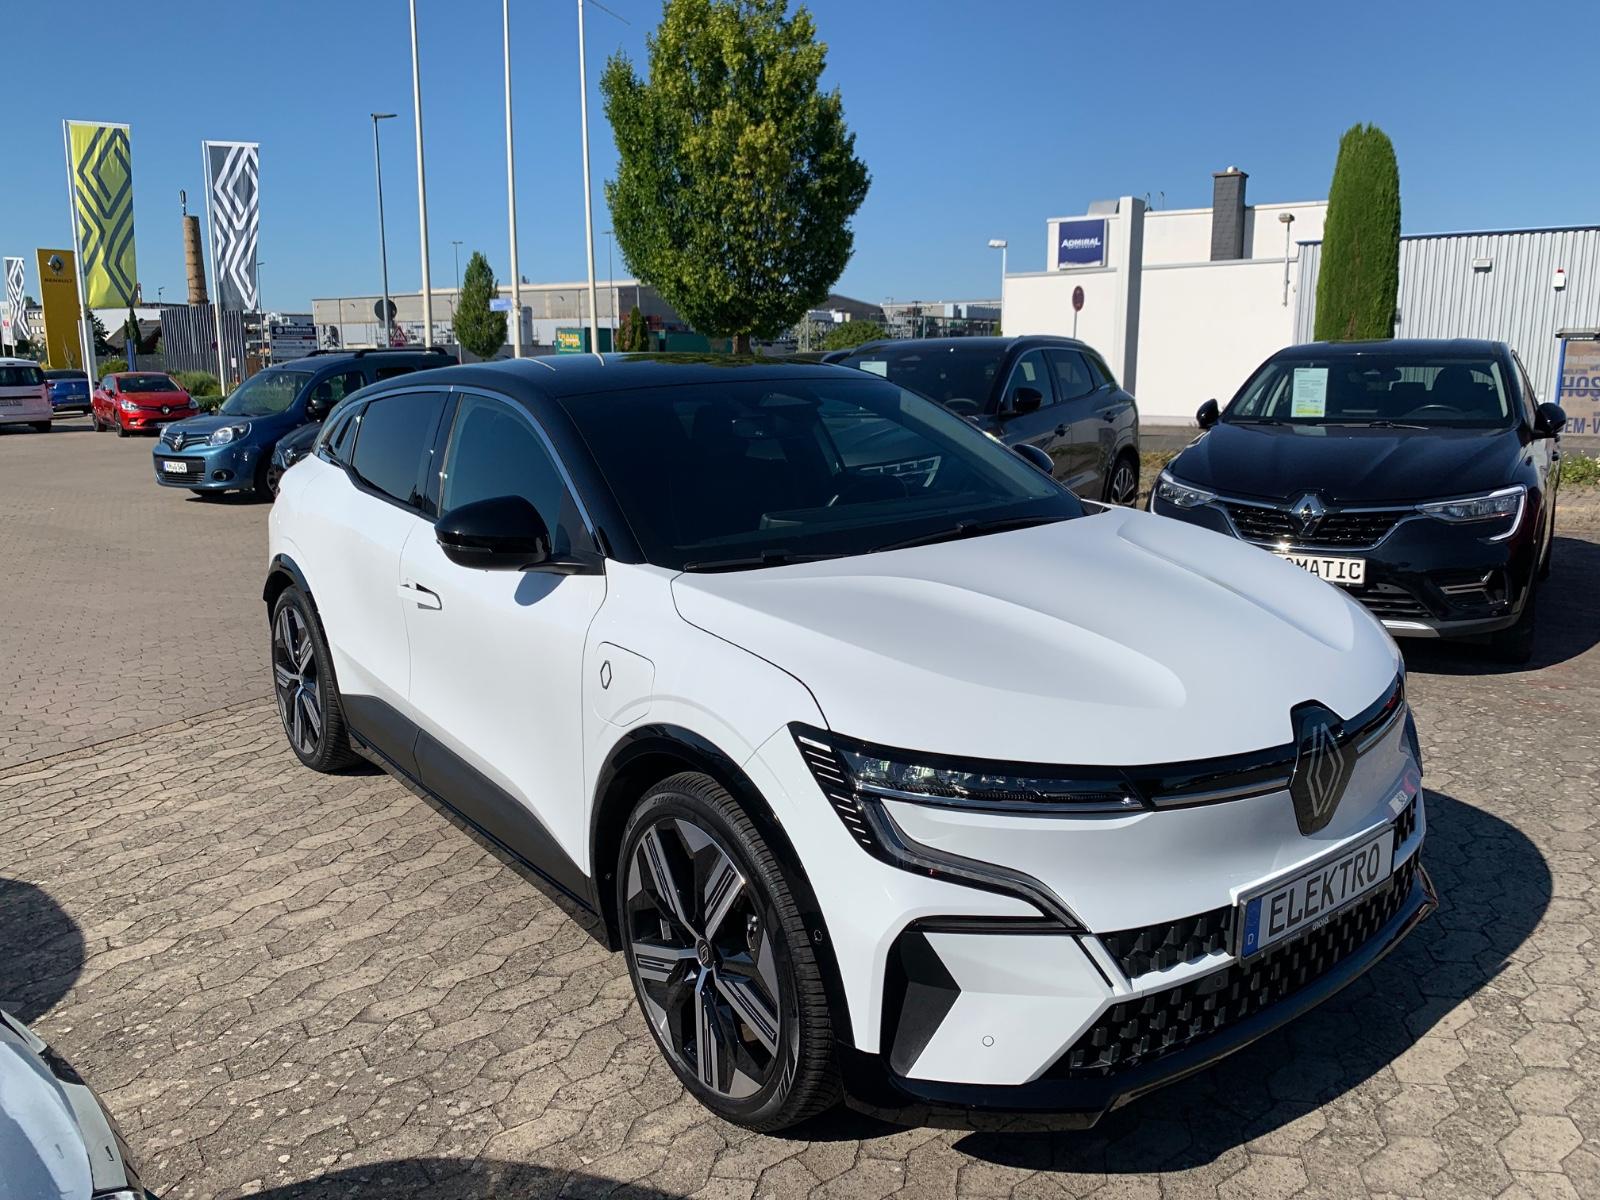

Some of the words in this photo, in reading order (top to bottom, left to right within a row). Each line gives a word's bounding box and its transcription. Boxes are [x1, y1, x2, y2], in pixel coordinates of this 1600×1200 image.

[1061, 237, 1101, 248] ADMIRAL
[1247, 933, 1254, 945] D
[1268, 842, 1380, 938] ELEKTRO
